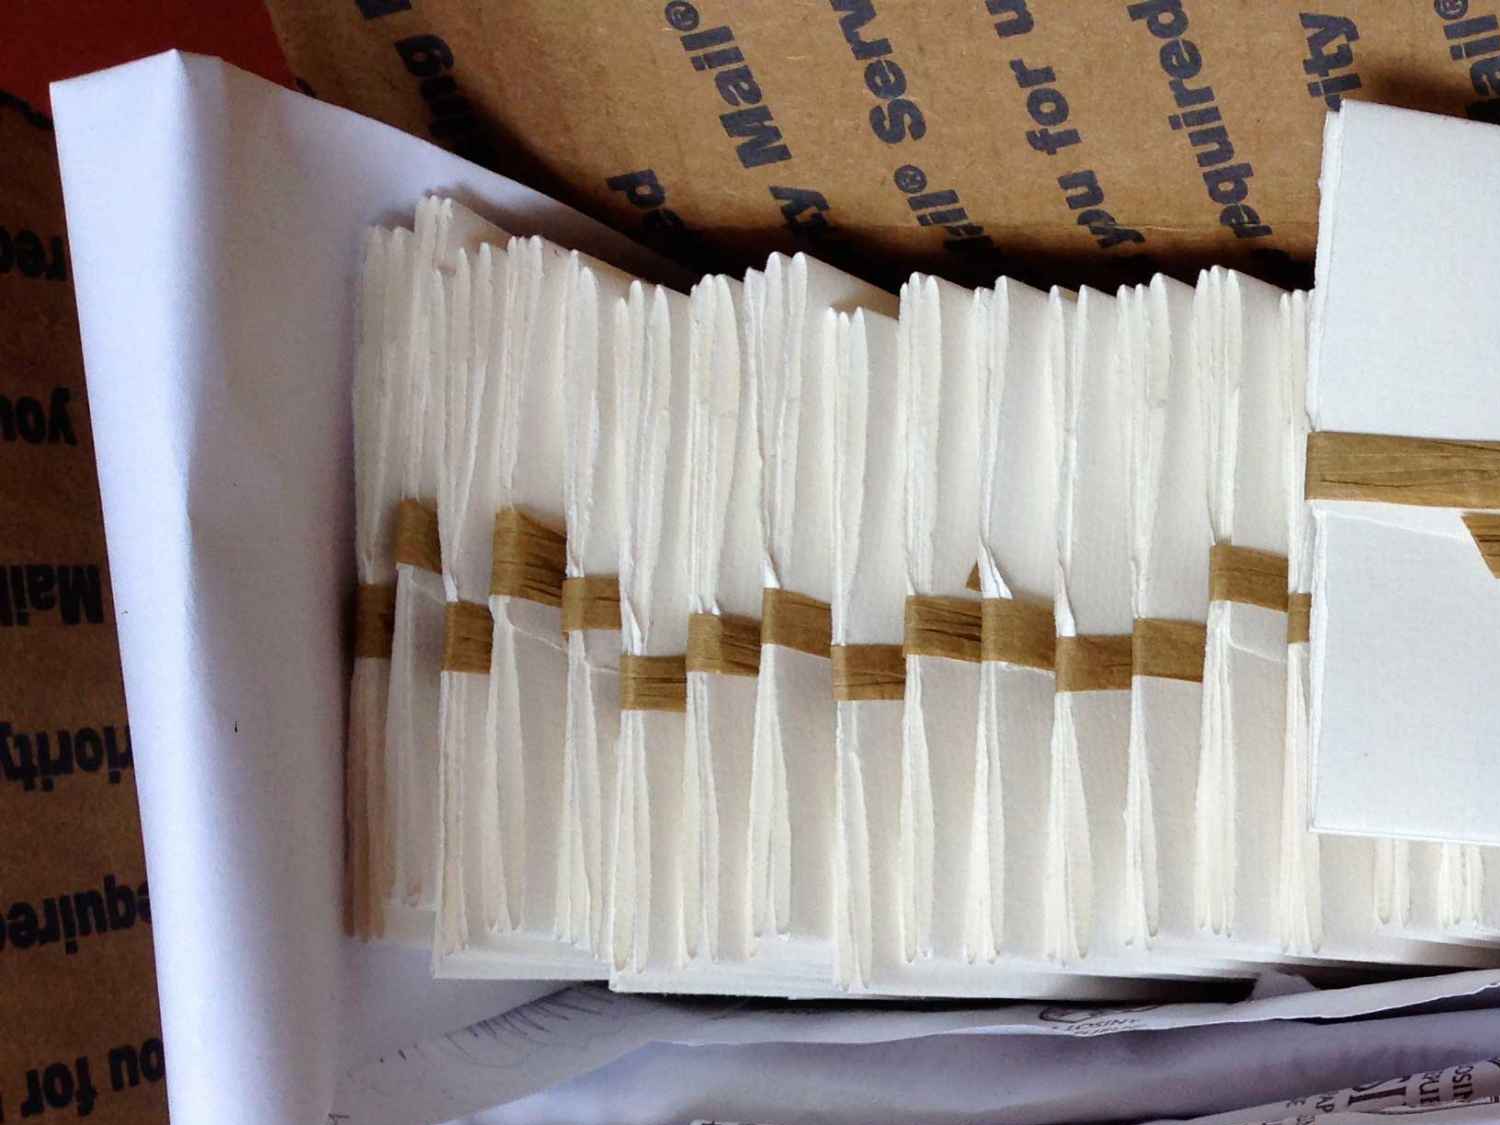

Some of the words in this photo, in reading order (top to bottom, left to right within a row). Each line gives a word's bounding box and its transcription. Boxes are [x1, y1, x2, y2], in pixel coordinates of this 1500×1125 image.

[1010, 58, 1082, 155] for
[1127, 0, 1273, 239] required
[21, 1057, 97, 1118] for
[109, 1037, 166, 1091] ou
